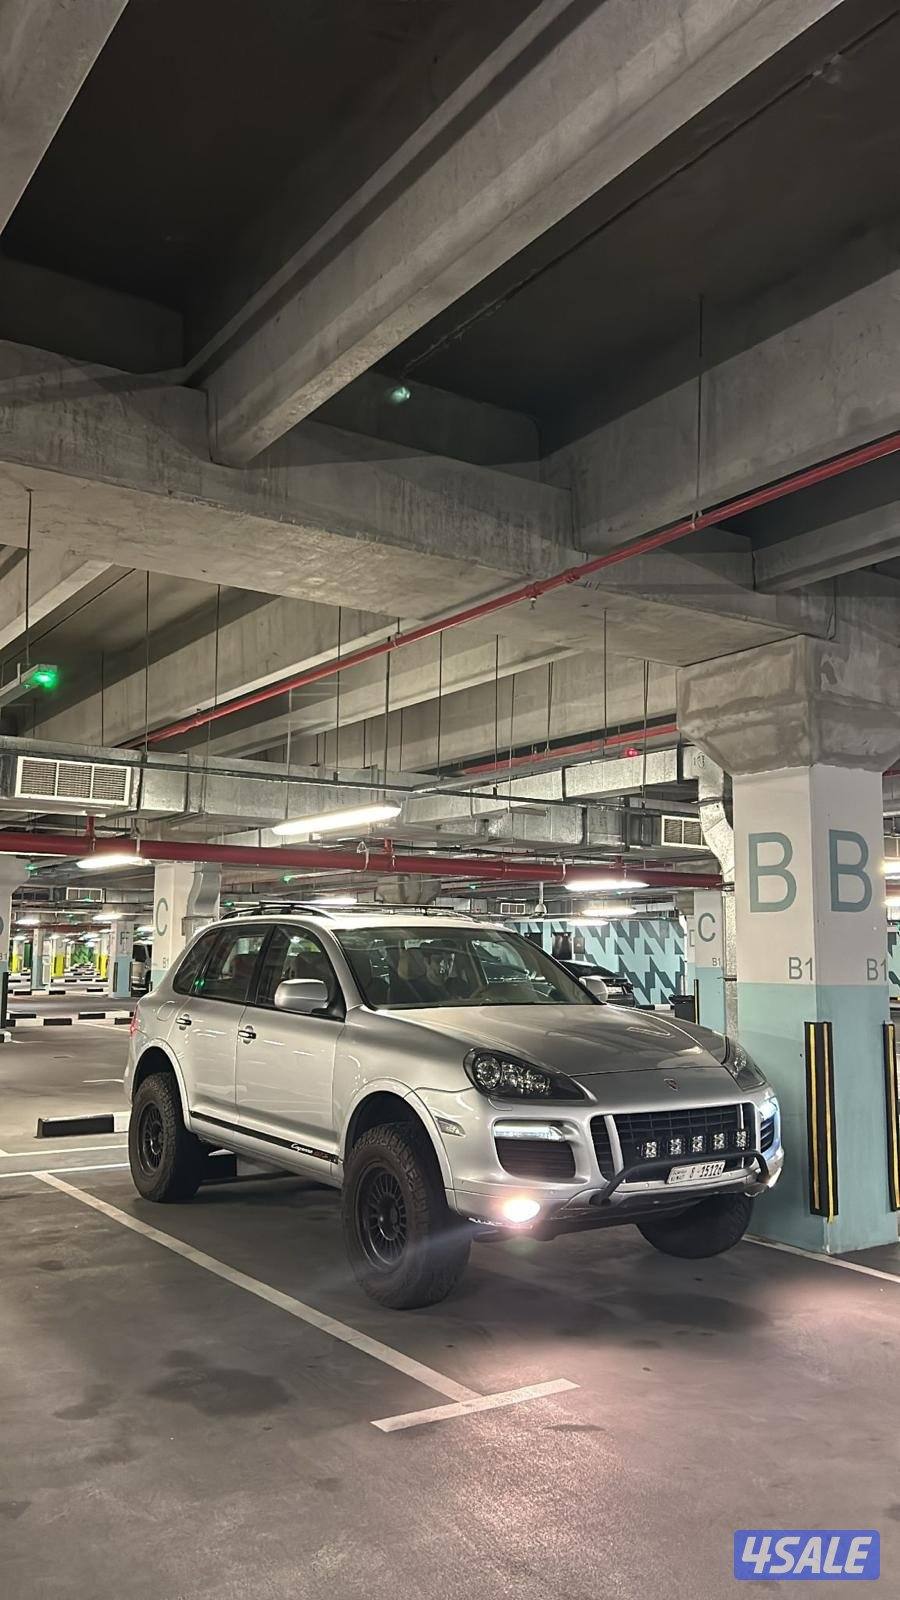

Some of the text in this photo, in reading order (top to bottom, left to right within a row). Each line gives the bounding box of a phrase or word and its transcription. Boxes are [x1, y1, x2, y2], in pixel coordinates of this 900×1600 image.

[748, 832, 797, 912] B
[829, 829, 872, 912] B
[156, 897, 168, 936] C
[697, 912, 716, 942] C
[712, 957, 721, 967] B1
[788, 956, 813, 981] B1
[866, 958, 887, 982] B1
